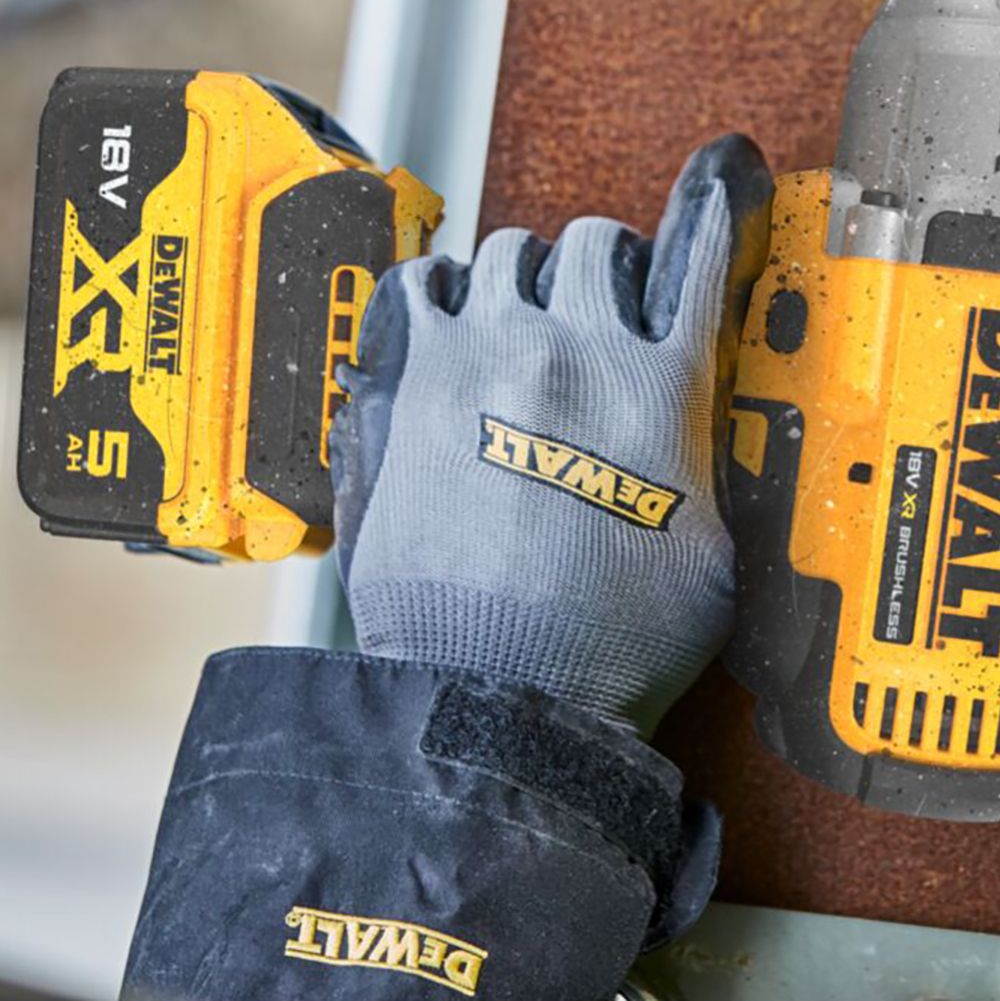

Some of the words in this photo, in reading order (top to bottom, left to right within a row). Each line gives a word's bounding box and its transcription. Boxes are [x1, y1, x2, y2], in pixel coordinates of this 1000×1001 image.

[99, 125, 132, 209] 18V
[53, 198, 142, 398] XR
[148, 234, 184, 375] DEWALT
[66, 432, 83, 472] AH
[87, 429, 129, 479] 5
[484, 429, 675, 522] DEWALT
[905, 451, 923, 489] 18V
[901, 491, 918, 519] XR
[886, 526, 912, 639] BRUSHLESS
[285, 914, 482, 988] DEWALT
